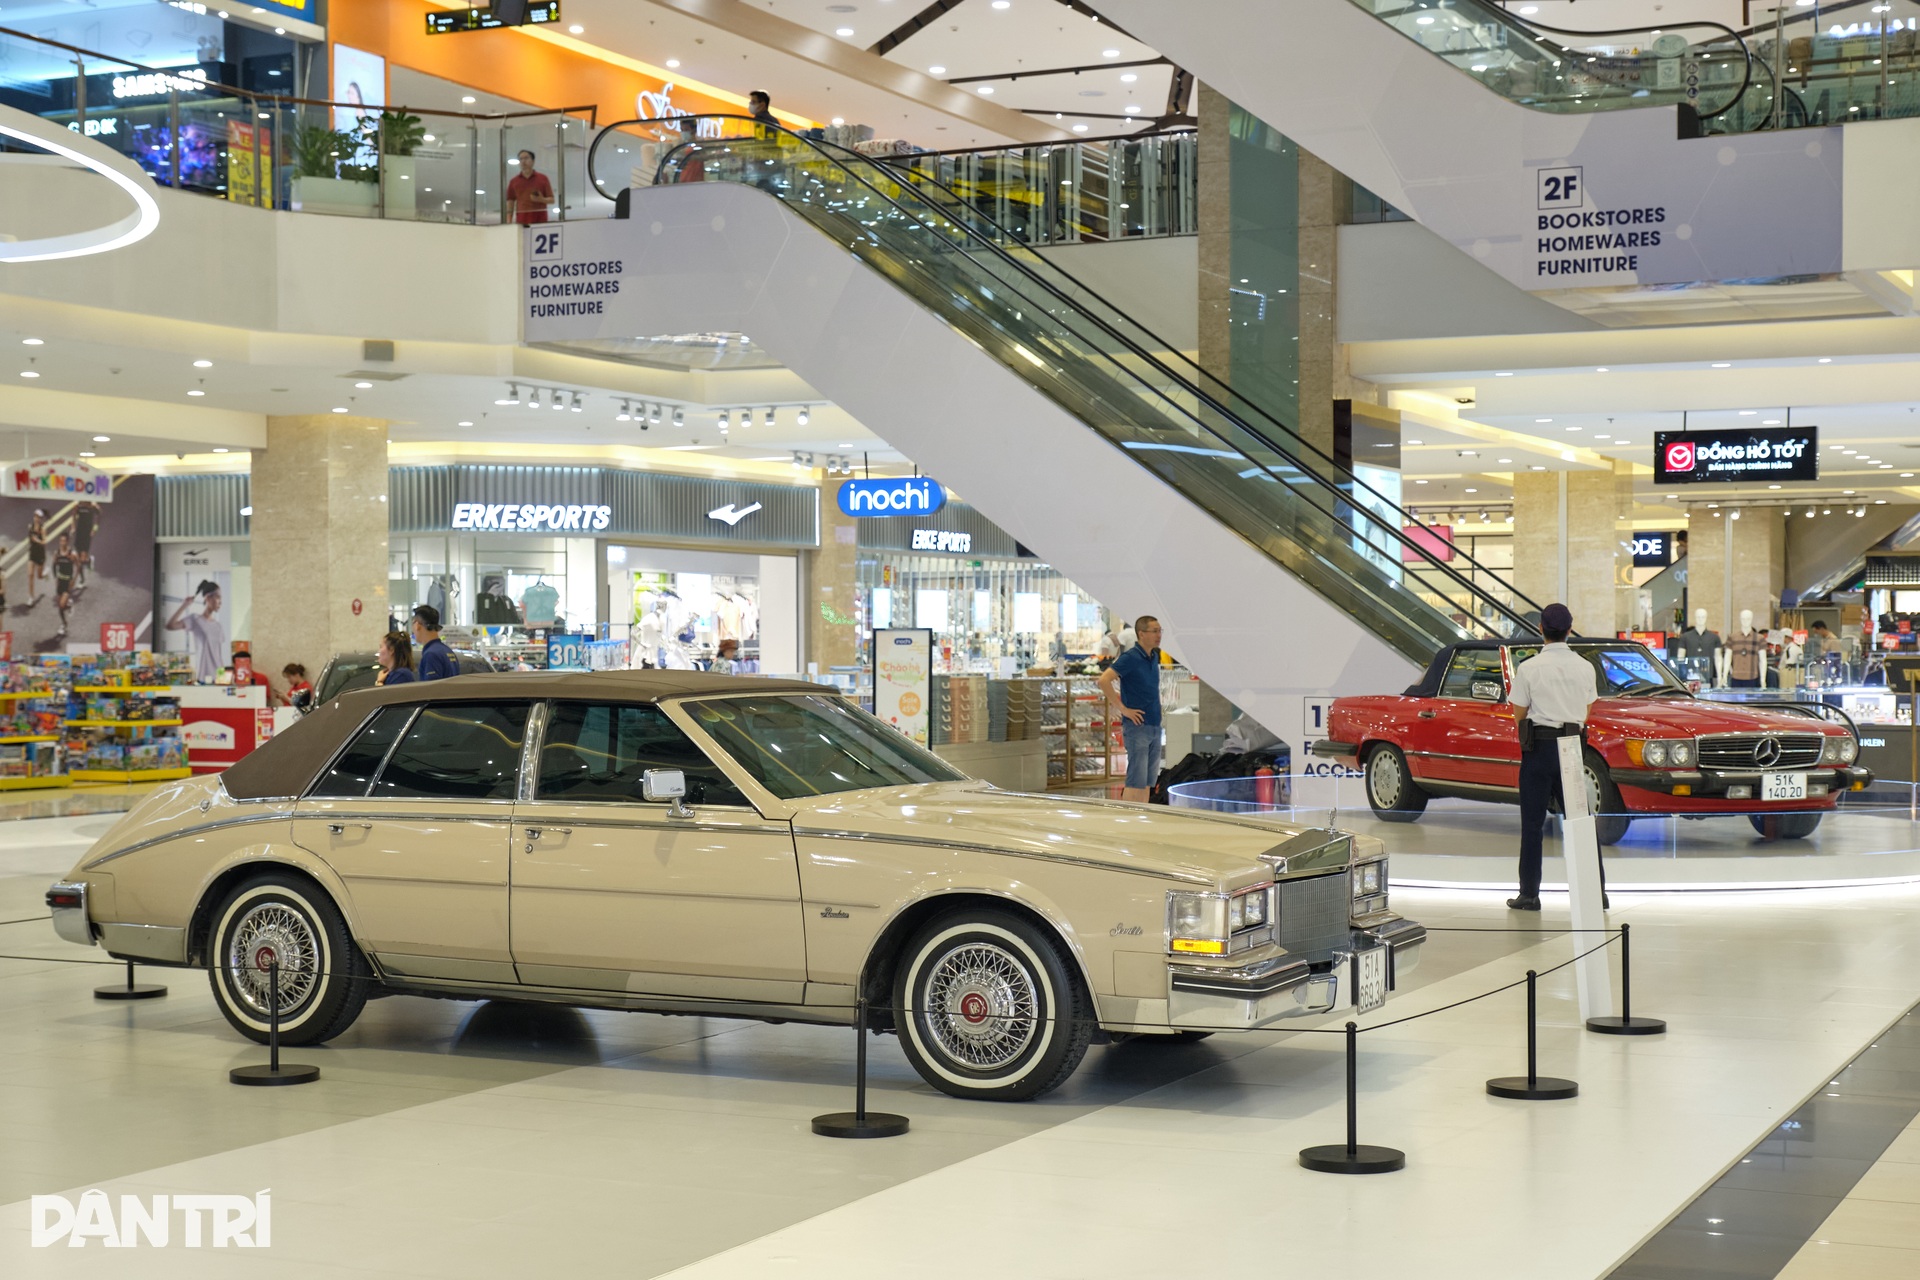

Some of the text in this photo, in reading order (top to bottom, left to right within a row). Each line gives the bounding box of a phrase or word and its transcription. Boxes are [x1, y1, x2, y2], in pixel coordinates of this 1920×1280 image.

[1544, 175, 1577, 201] 2F
[1538, 207, 1666, 230] BOOKSTORES
[535, 233, 559, 254] 2F
[1538, 230, 1661, 253] HOMEWARES
[530, 260, 623, 279] BOOKSTORES
[1538, 255, 1638, 276] FURNITURE
[530, 280, 620, 298] HOMEWARES
[530, 301, 603, 318] FURNITURE
[1697, 438, 1805, 460] ĐỒNG HỒ TỐT
[849, 481, 930, 511] inochi
[911, 529, 971, 553] ERKE SPORTS
[1775, 774, 1794, 786] 51K
[1768, 787, 1803, 799] 140.20
[1365, 952, 1379, 980] 51A
